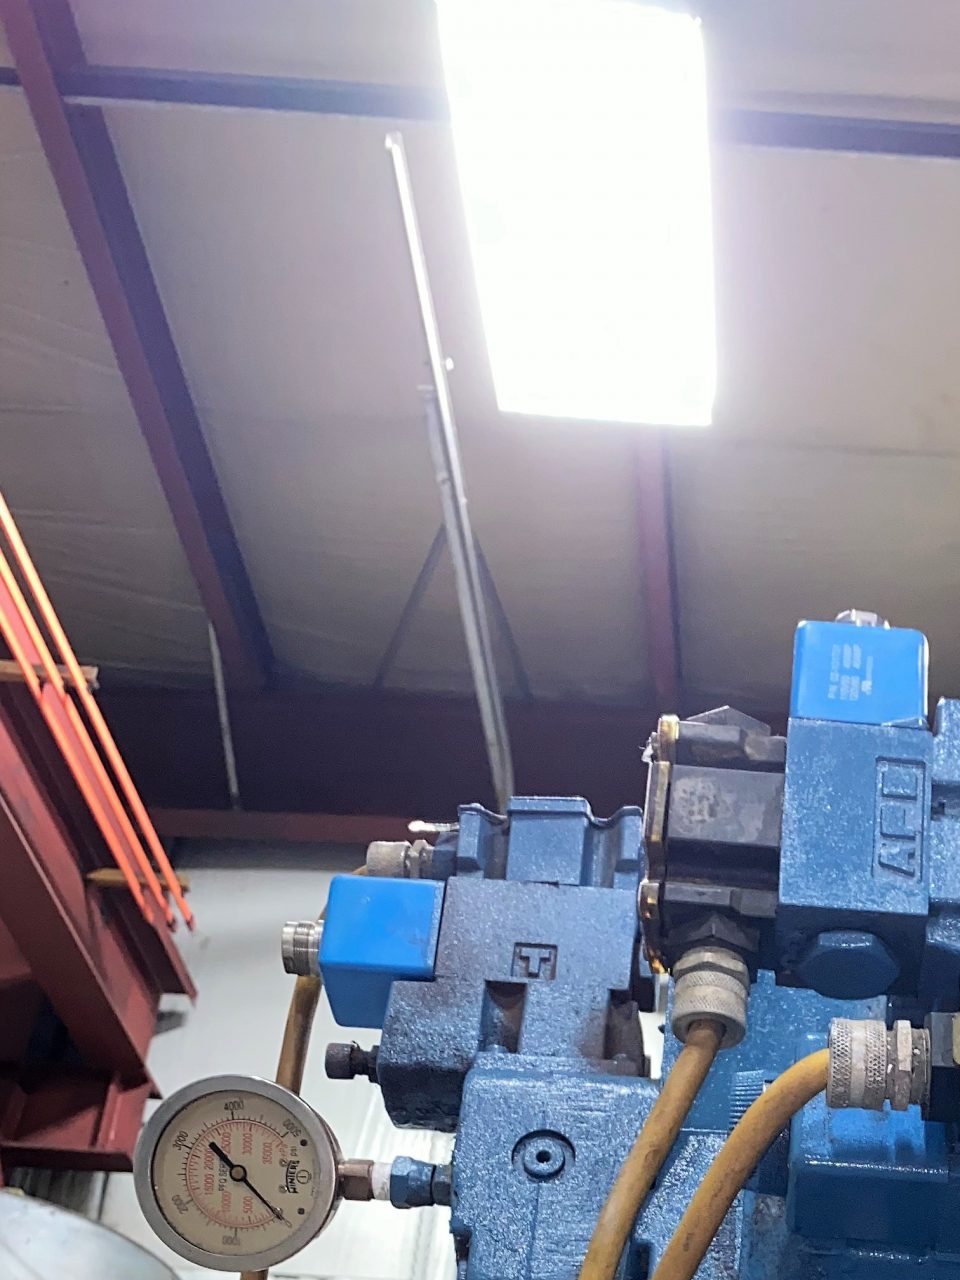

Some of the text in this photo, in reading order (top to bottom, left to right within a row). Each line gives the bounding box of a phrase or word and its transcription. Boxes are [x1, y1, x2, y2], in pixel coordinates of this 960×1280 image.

[223, 1101, 245, 1111] 4000
[172, 1130, 189, 1150] 3000
[262, 1142, 273, 1165] 35000
[286, 1160, 300, 1194] WINTERS
[171, 1194, 189, 1215] 2000
[242, 1195, 253, 1215] 5000
